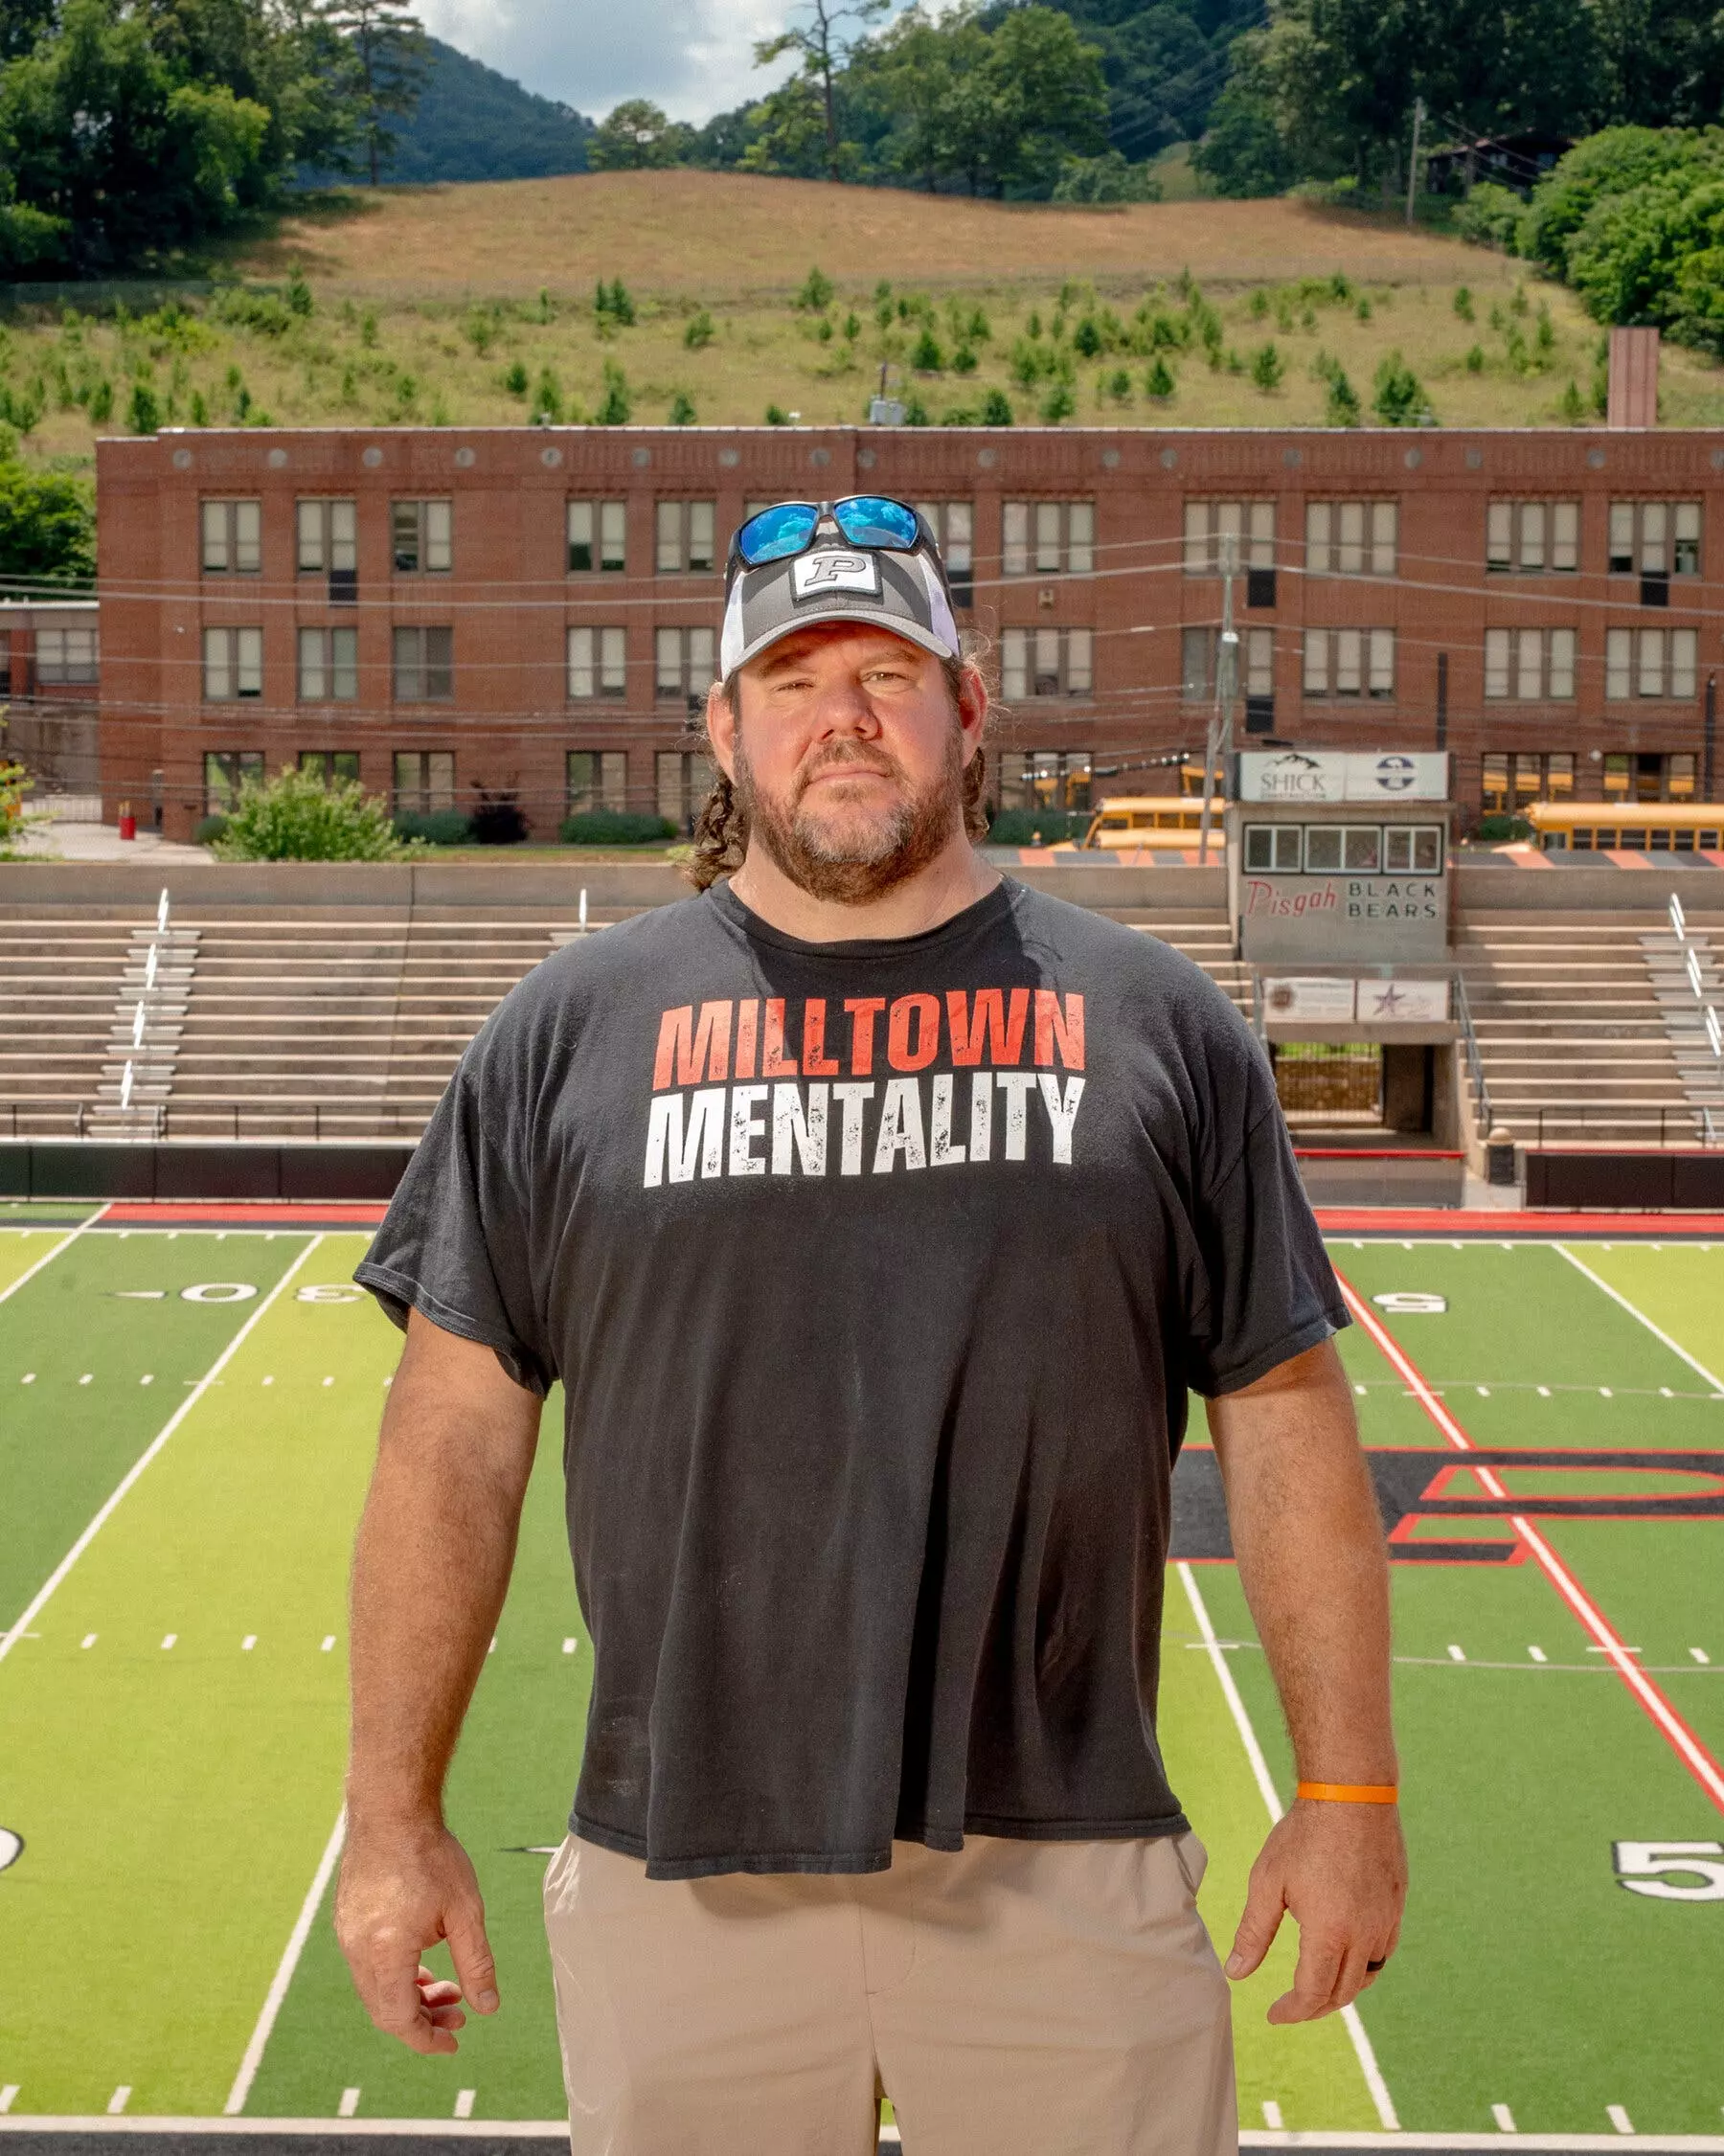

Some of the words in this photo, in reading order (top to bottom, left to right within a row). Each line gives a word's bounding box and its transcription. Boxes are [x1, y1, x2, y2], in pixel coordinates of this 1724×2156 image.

[804, 555, 867, 587] P
[1259, 772, 1327, 792] SHICK
[1247, 880, 1337, 919] Pisgah
[1348, 881, 1437, 898] BLACK
[1348, 903, 1437, 919] BEARS
[652, 987, 1086, 1092] MILLTOWN
[643, 1071, 1087, 1189] MENTALITY
[1611, 1840, 1724, 1903] 5
